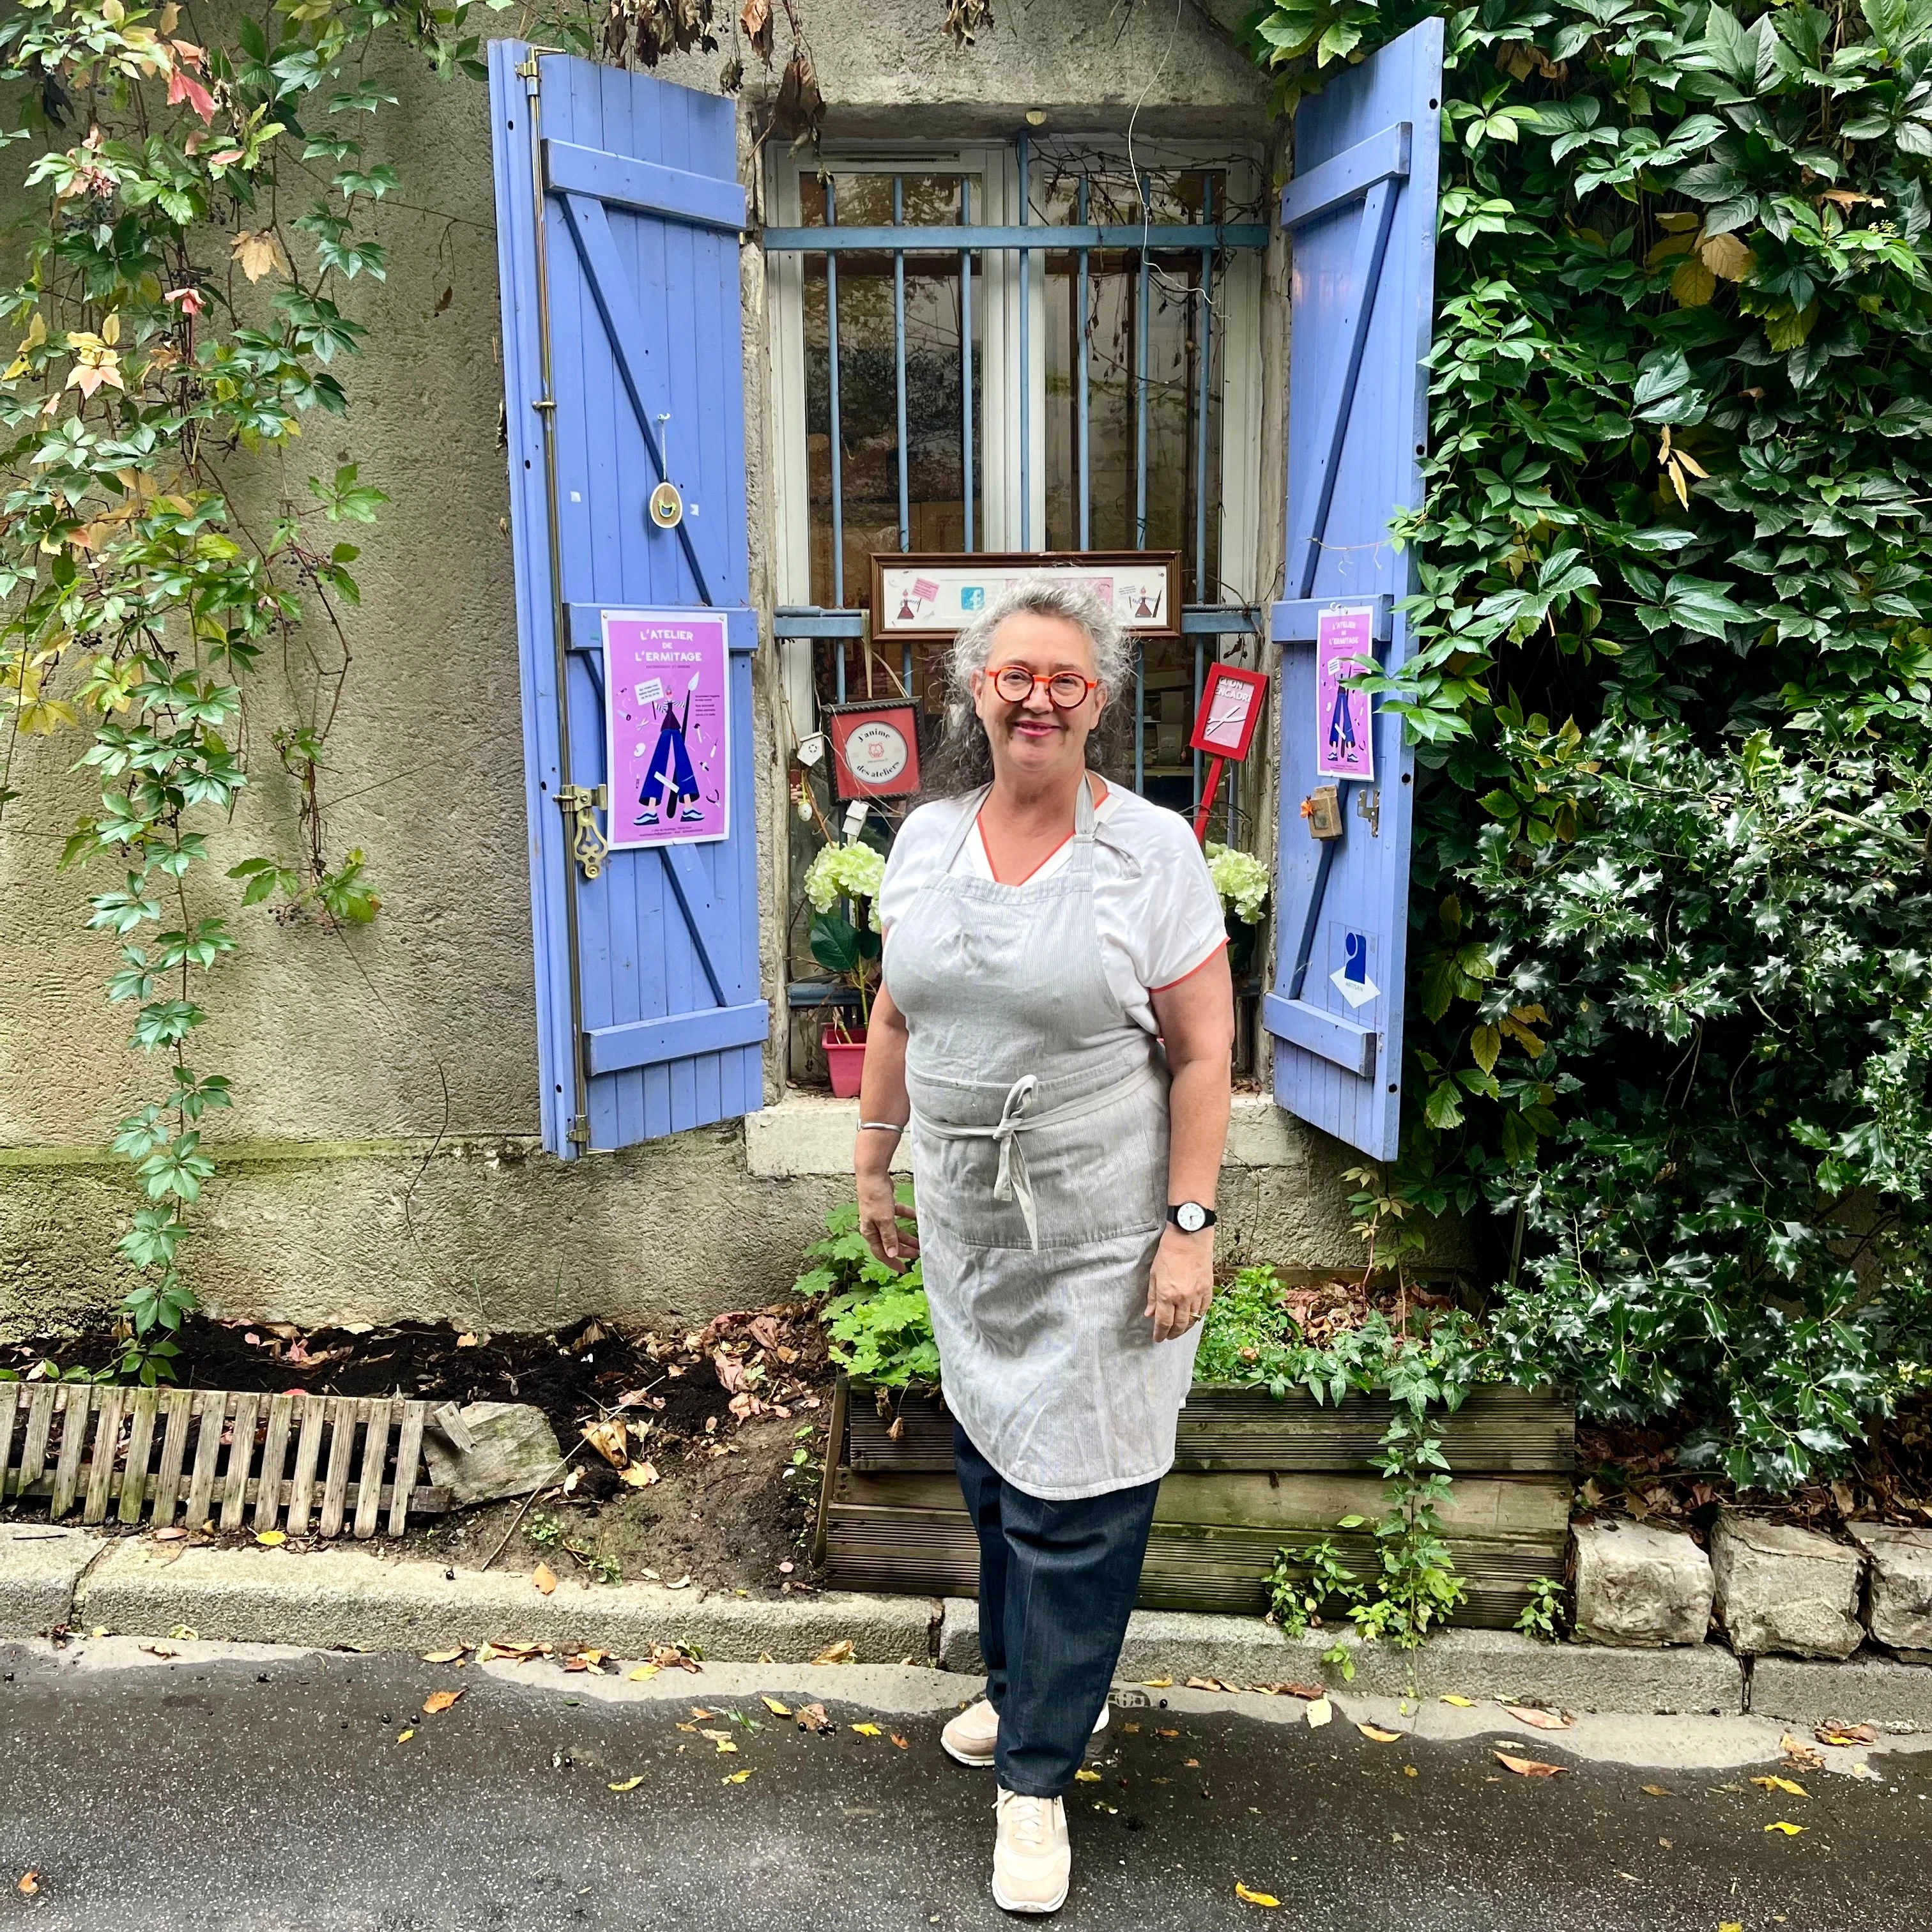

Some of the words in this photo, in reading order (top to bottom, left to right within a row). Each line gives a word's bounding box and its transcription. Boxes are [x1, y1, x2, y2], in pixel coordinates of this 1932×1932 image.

[640, 629, 693, 641] L'ATELIER
[635, 651, 702, 661] L'ERMITAGE
[857, 765, 870, 776] des
[871, 762, 900, 778] ateliers
